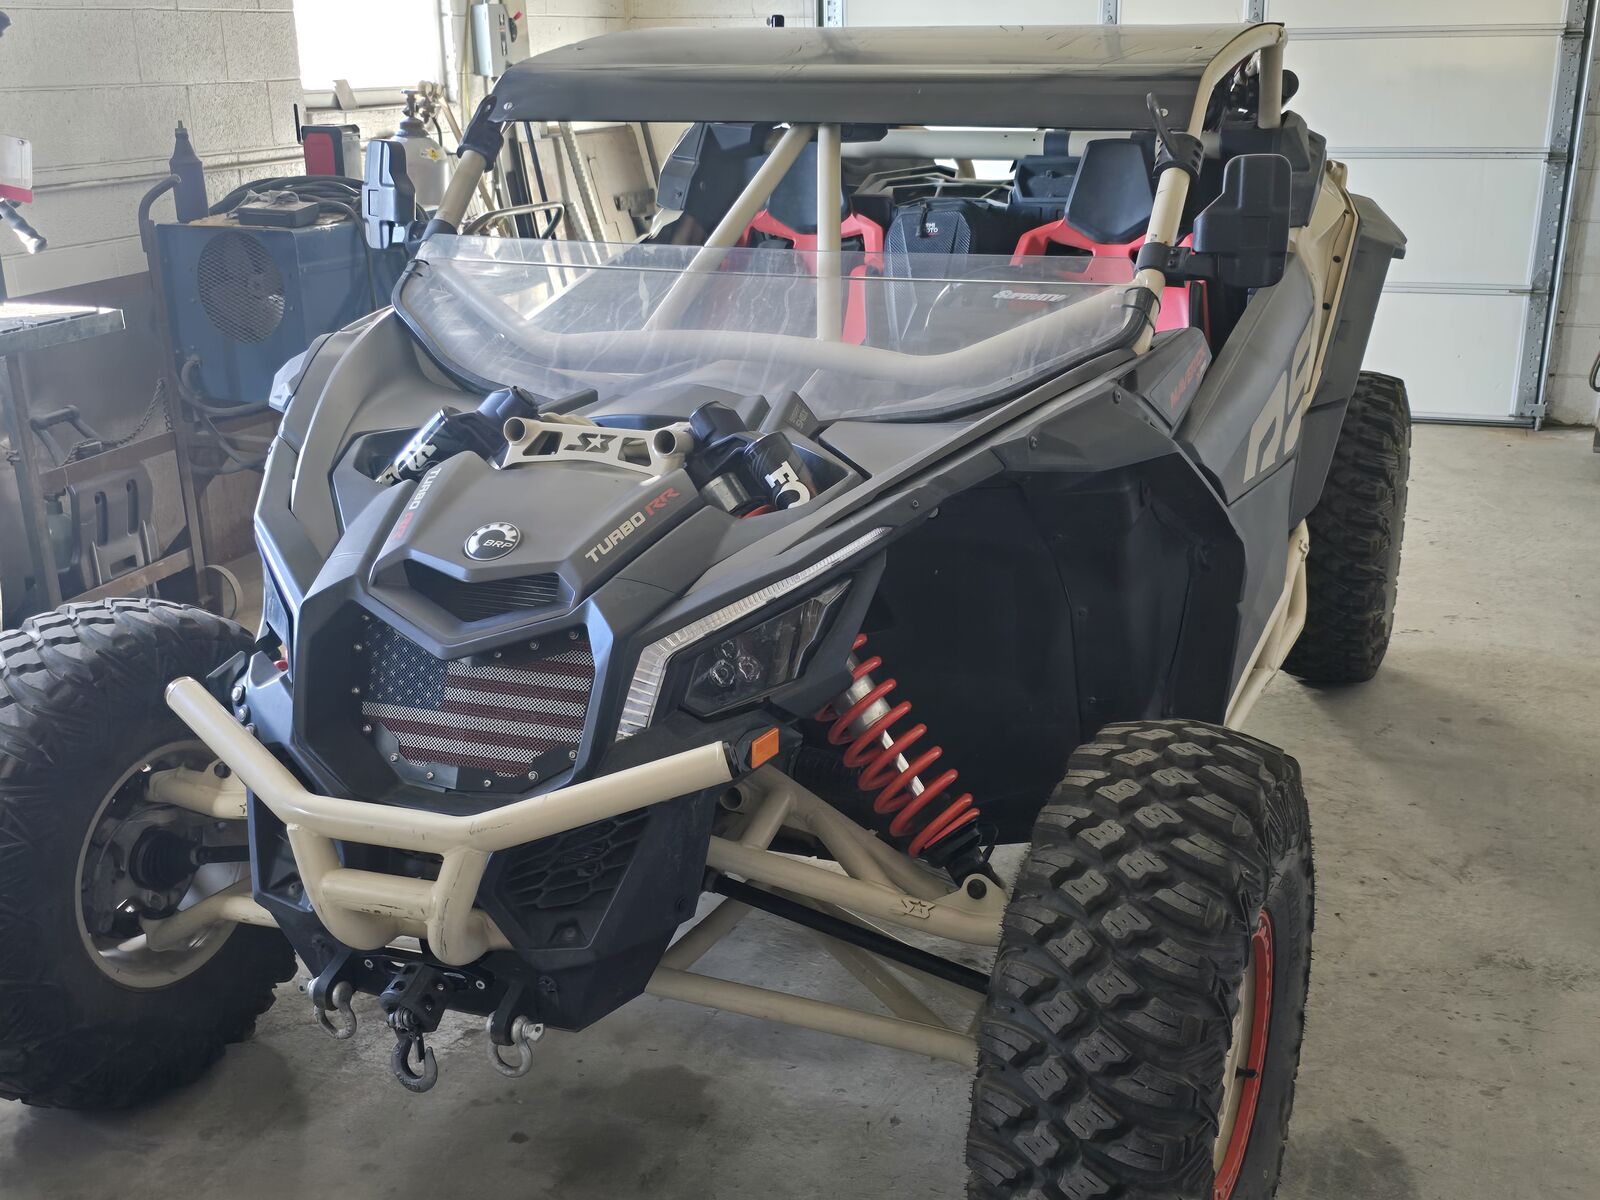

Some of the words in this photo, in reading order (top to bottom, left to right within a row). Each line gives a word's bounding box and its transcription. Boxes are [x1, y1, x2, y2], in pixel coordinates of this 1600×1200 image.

[408, 467, 442, 510] TURBO
[764, 460, 810, 509] FO
[483, 539, 513, 549] BRP
[584, 511, 646, 562] TURBO
[644, 487, 680, 516] RR
